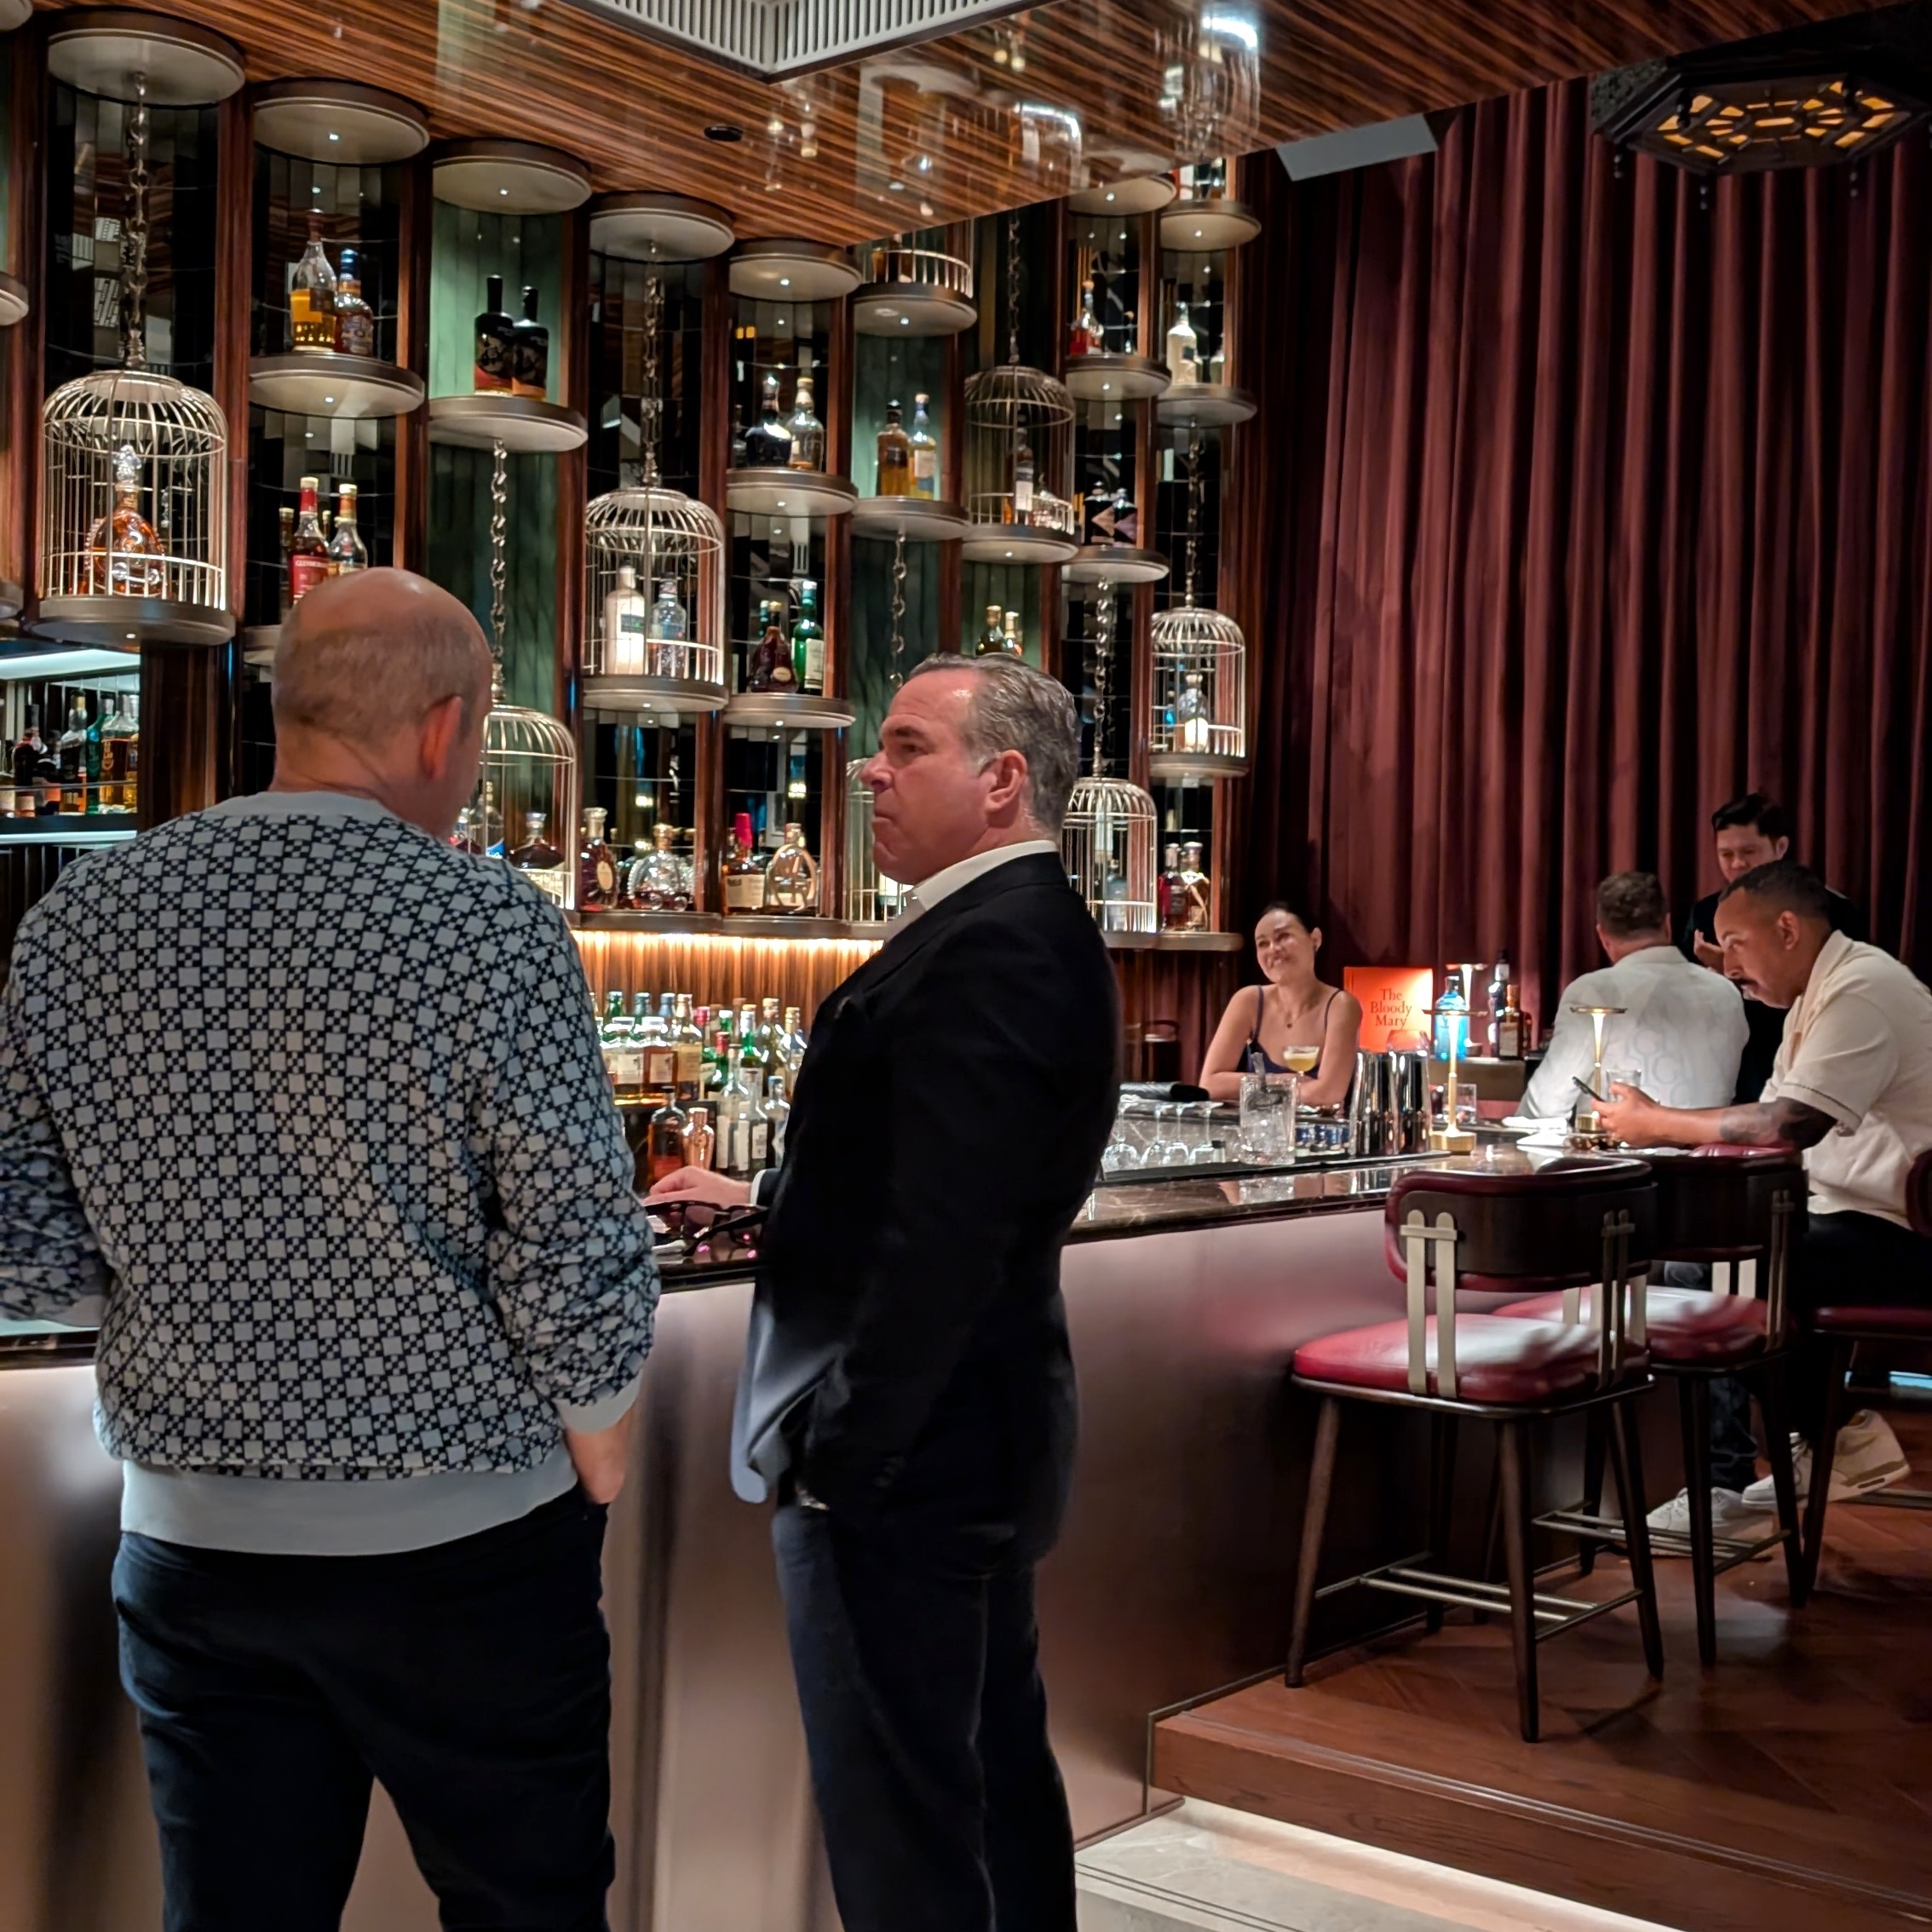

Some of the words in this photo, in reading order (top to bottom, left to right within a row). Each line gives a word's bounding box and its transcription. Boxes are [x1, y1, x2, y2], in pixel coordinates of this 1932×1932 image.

[1379, 988, 1403, 1001] The
[1370, 1001, 1412, 1016] Bloody
[1376, 1015, 1406, 1030] Mary
